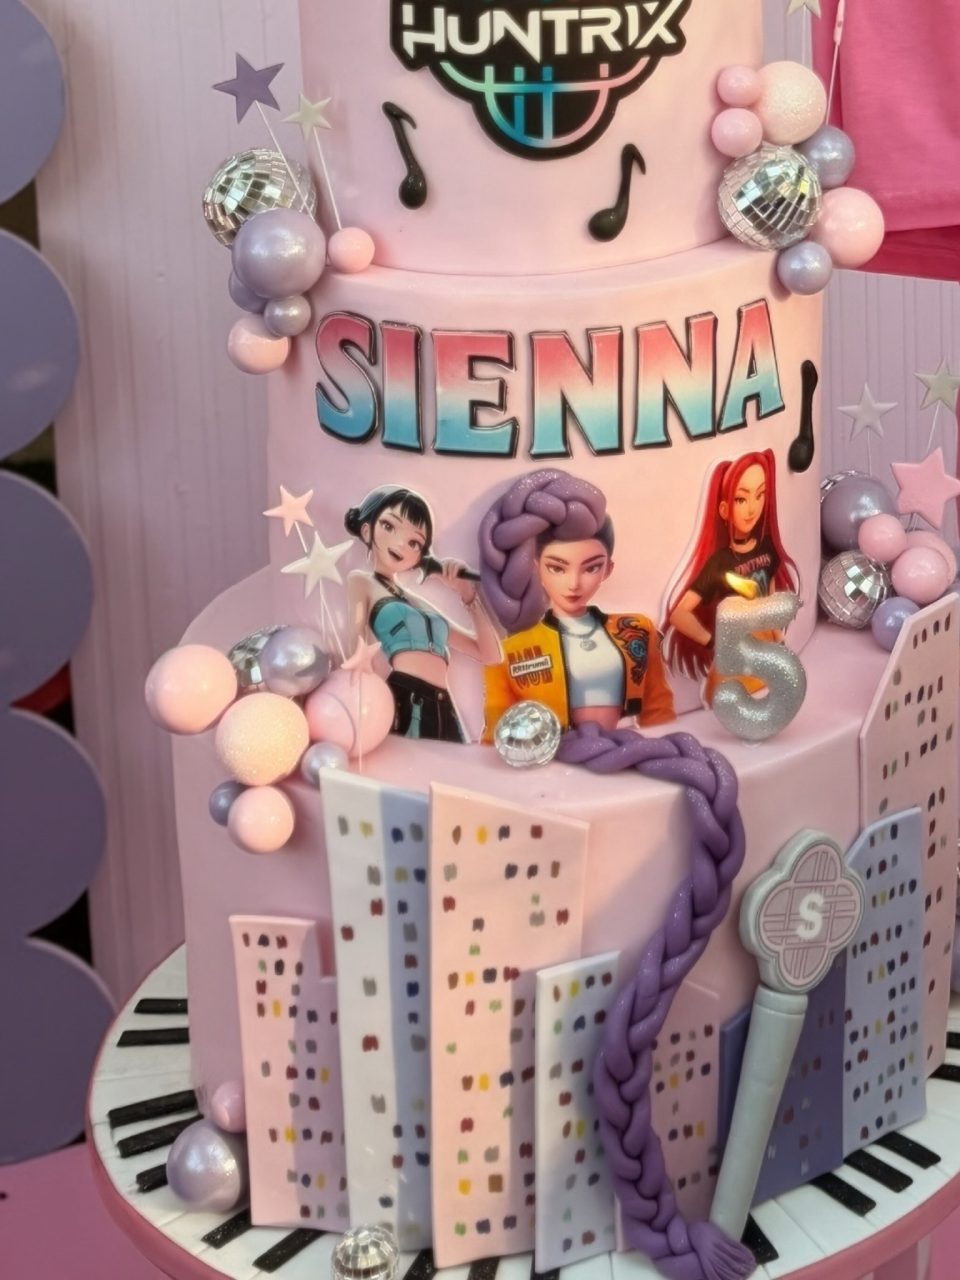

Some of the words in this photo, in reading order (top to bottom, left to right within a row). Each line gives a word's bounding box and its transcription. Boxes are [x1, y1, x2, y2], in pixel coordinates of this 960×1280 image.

[315, 297, 786, 460] SIENNA
[712, 591, 808, 742] 5
[797, 892, 825, 940] S
